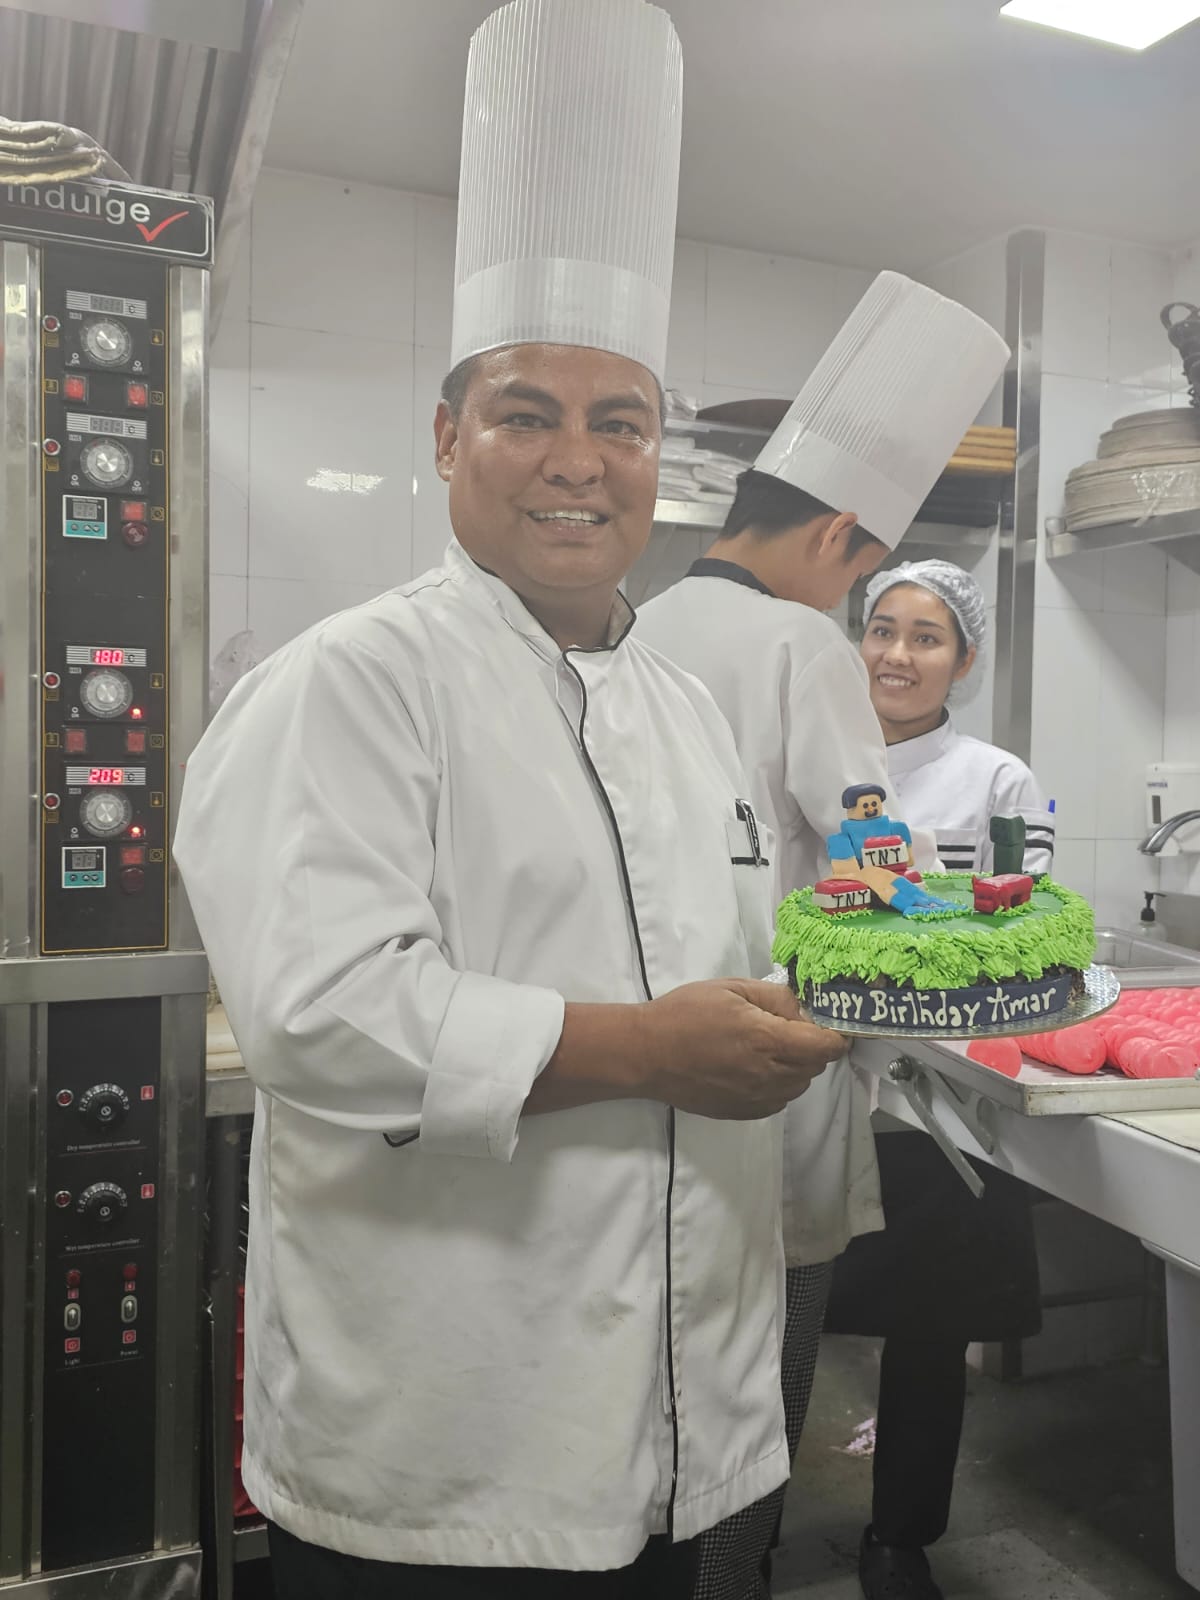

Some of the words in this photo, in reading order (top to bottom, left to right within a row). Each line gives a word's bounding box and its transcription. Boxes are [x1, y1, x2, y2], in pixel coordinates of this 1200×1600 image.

[94, 649, 123, 664] 180
[813, 983, 863, 1019] Happy
[869, 986, 980, 1027] Birthday
